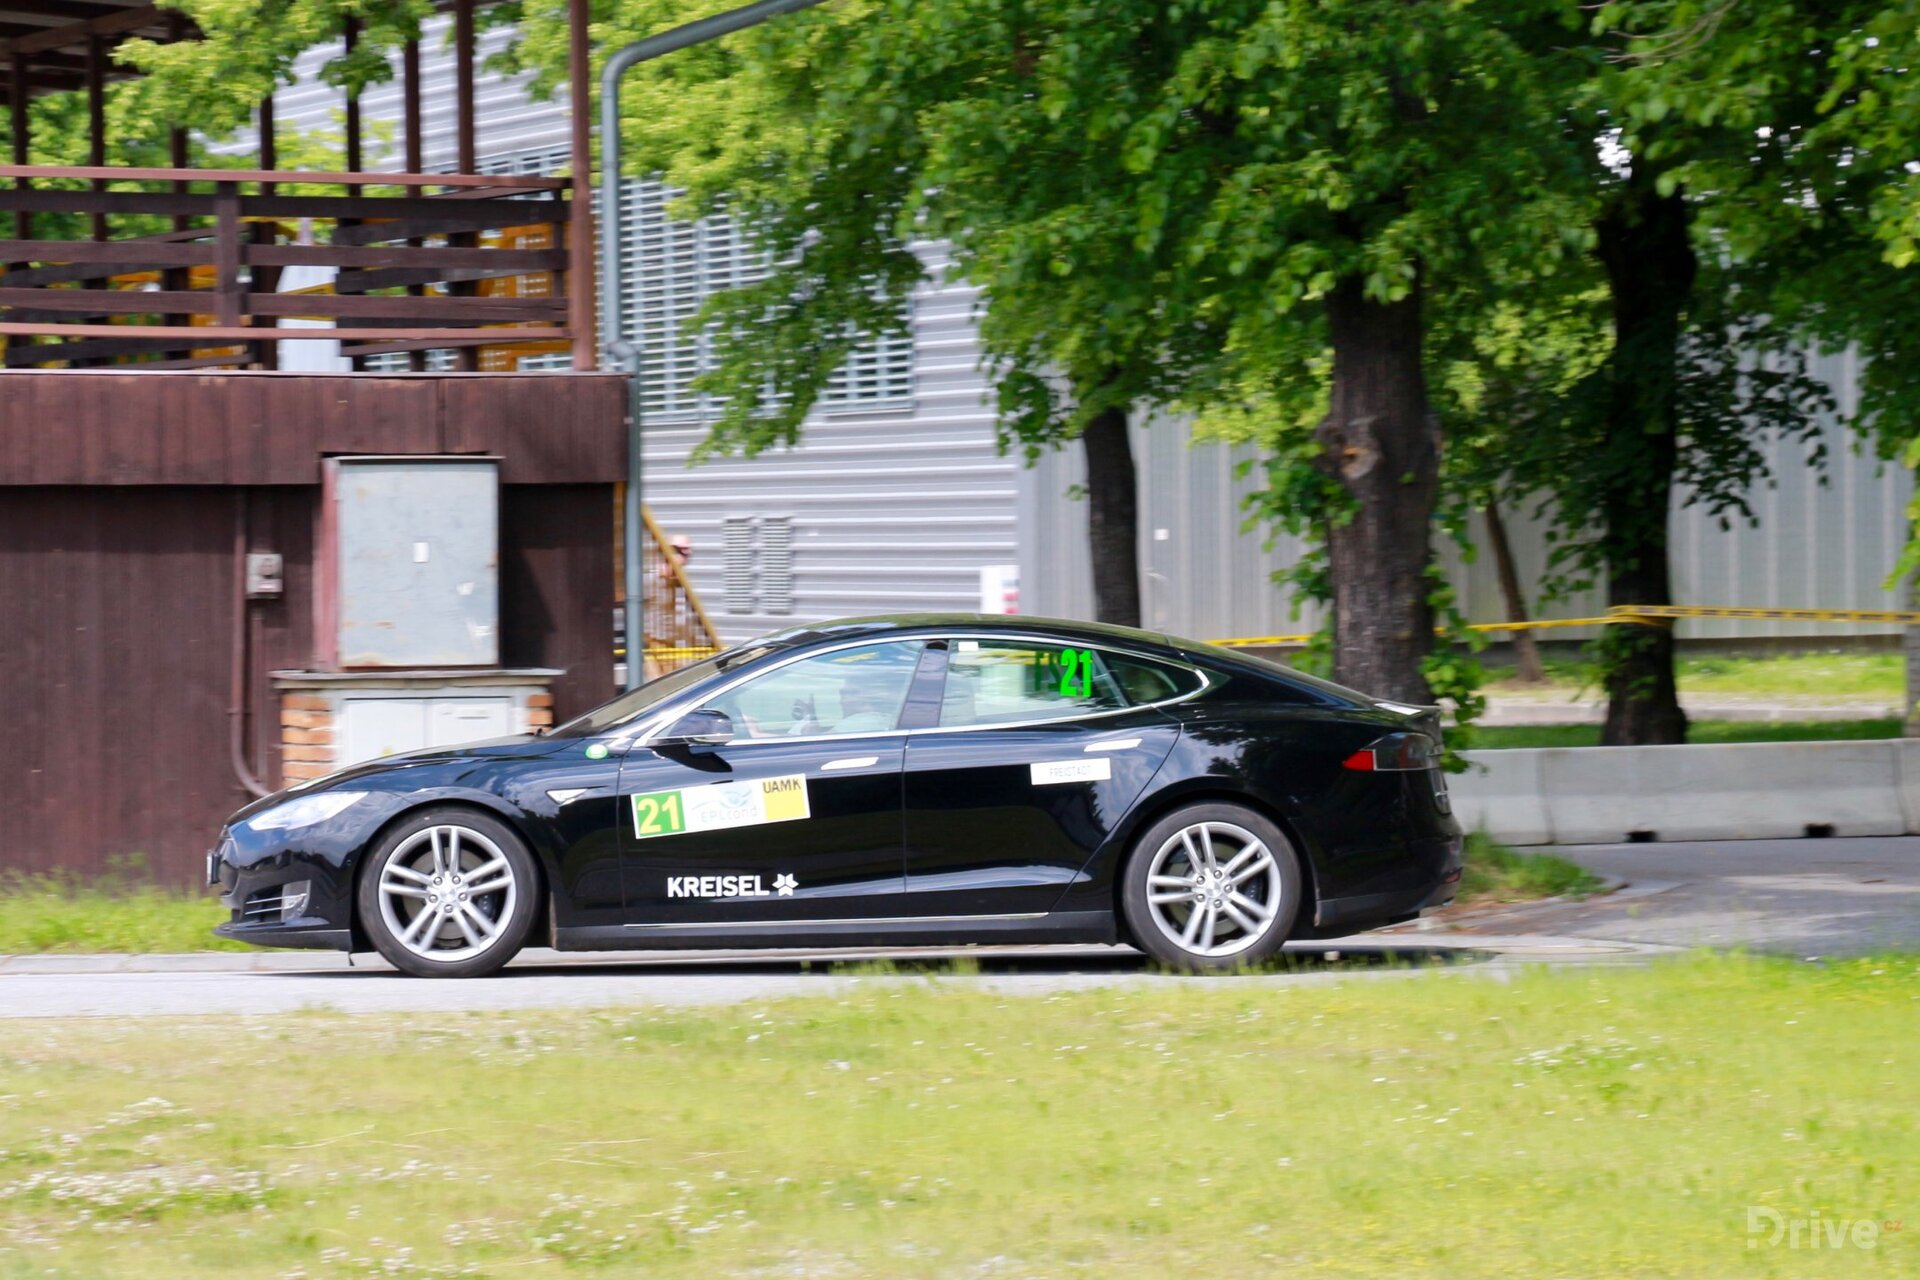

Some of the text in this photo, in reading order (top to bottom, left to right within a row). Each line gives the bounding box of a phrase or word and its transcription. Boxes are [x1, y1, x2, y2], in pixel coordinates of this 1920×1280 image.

[1060, 649, 1092, 697] 21
[636, 795, 680, 835] 21
[667, 875, 770, 898] KREISEL
